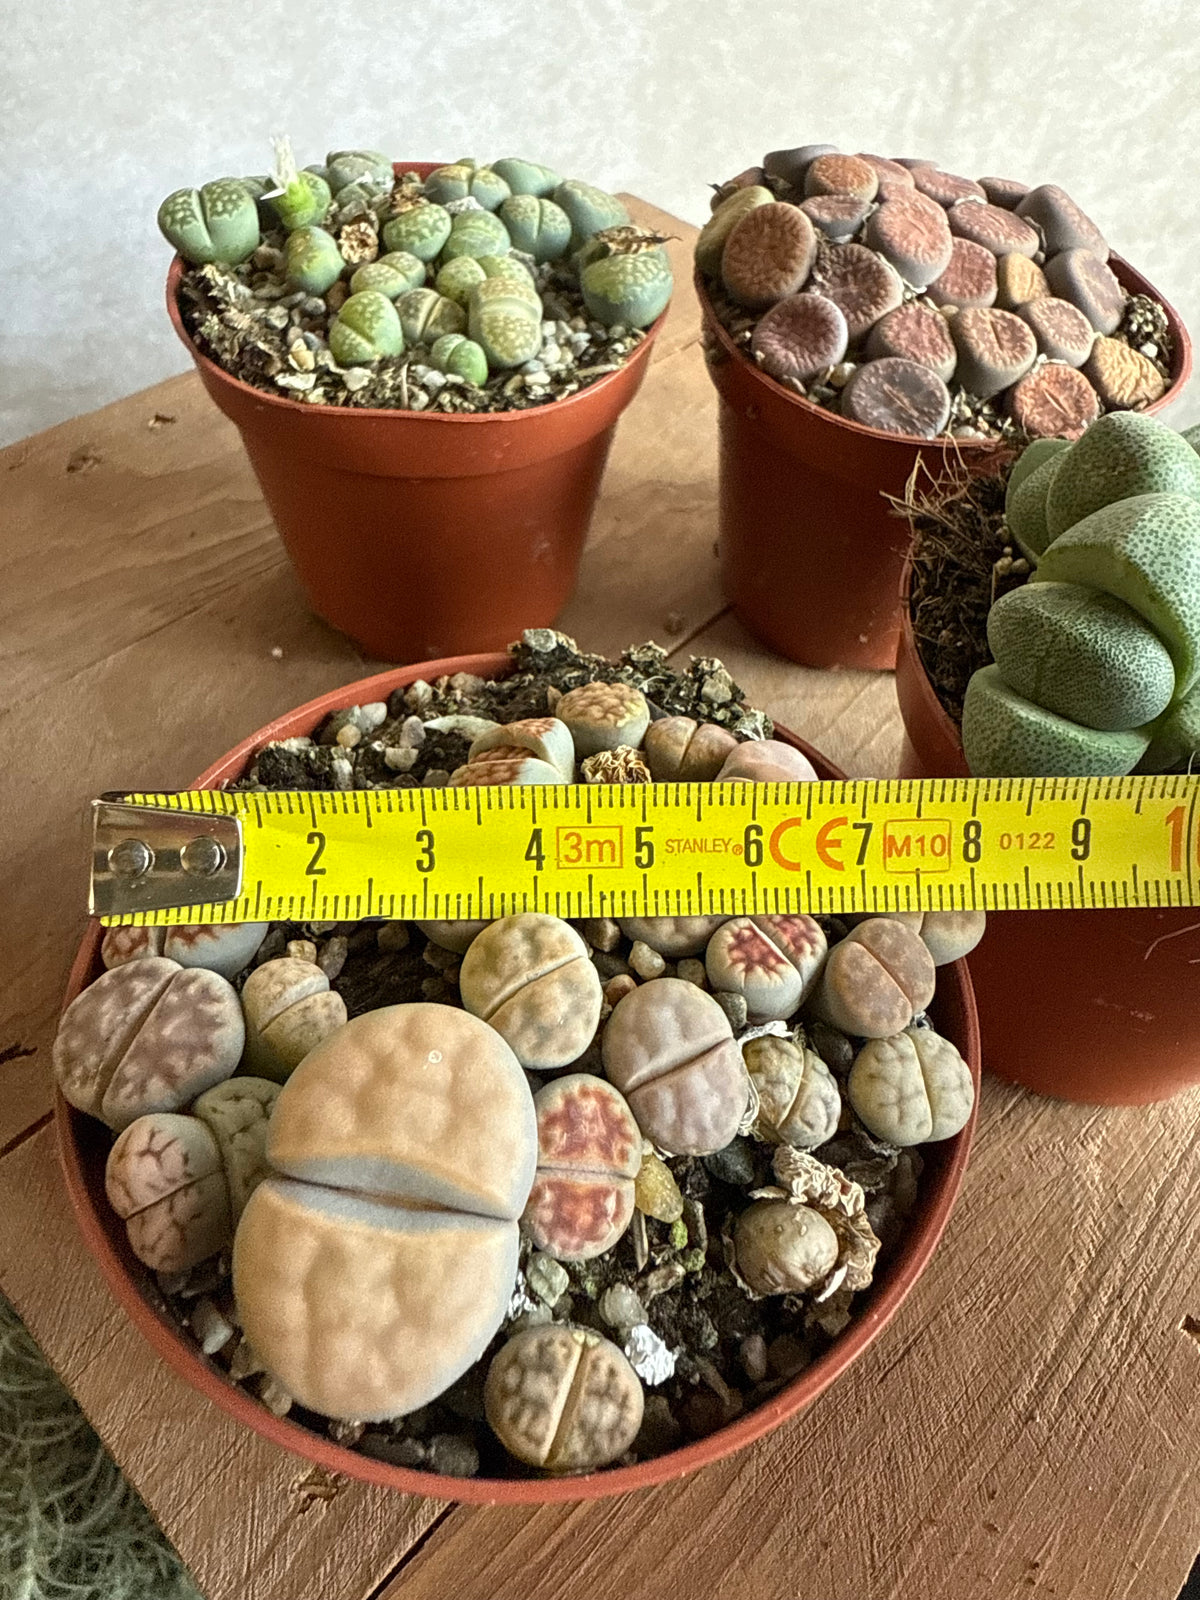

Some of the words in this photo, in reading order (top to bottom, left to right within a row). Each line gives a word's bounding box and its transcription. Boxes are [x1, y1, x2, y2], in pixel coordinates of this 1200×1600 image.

[305, 832, 327, 876] 2
[415, 829, 436, 872] 3
[525, 828, 546, 871] 4
[563, 832, 616, 863] 3m
[634, 826, 655, 869] 5
[743, 824, 764, 867] 6
[768, 816, 849, 872] CE
[852, 822, 873, 866] 7
[887, 834, 947, 858] M10
[962, 820, 982, 863] 8
[999, 832, 1056, 850] 0122
[1070, 817, 1092, 861] 9
[1165, 805, 1200, 872] 1
